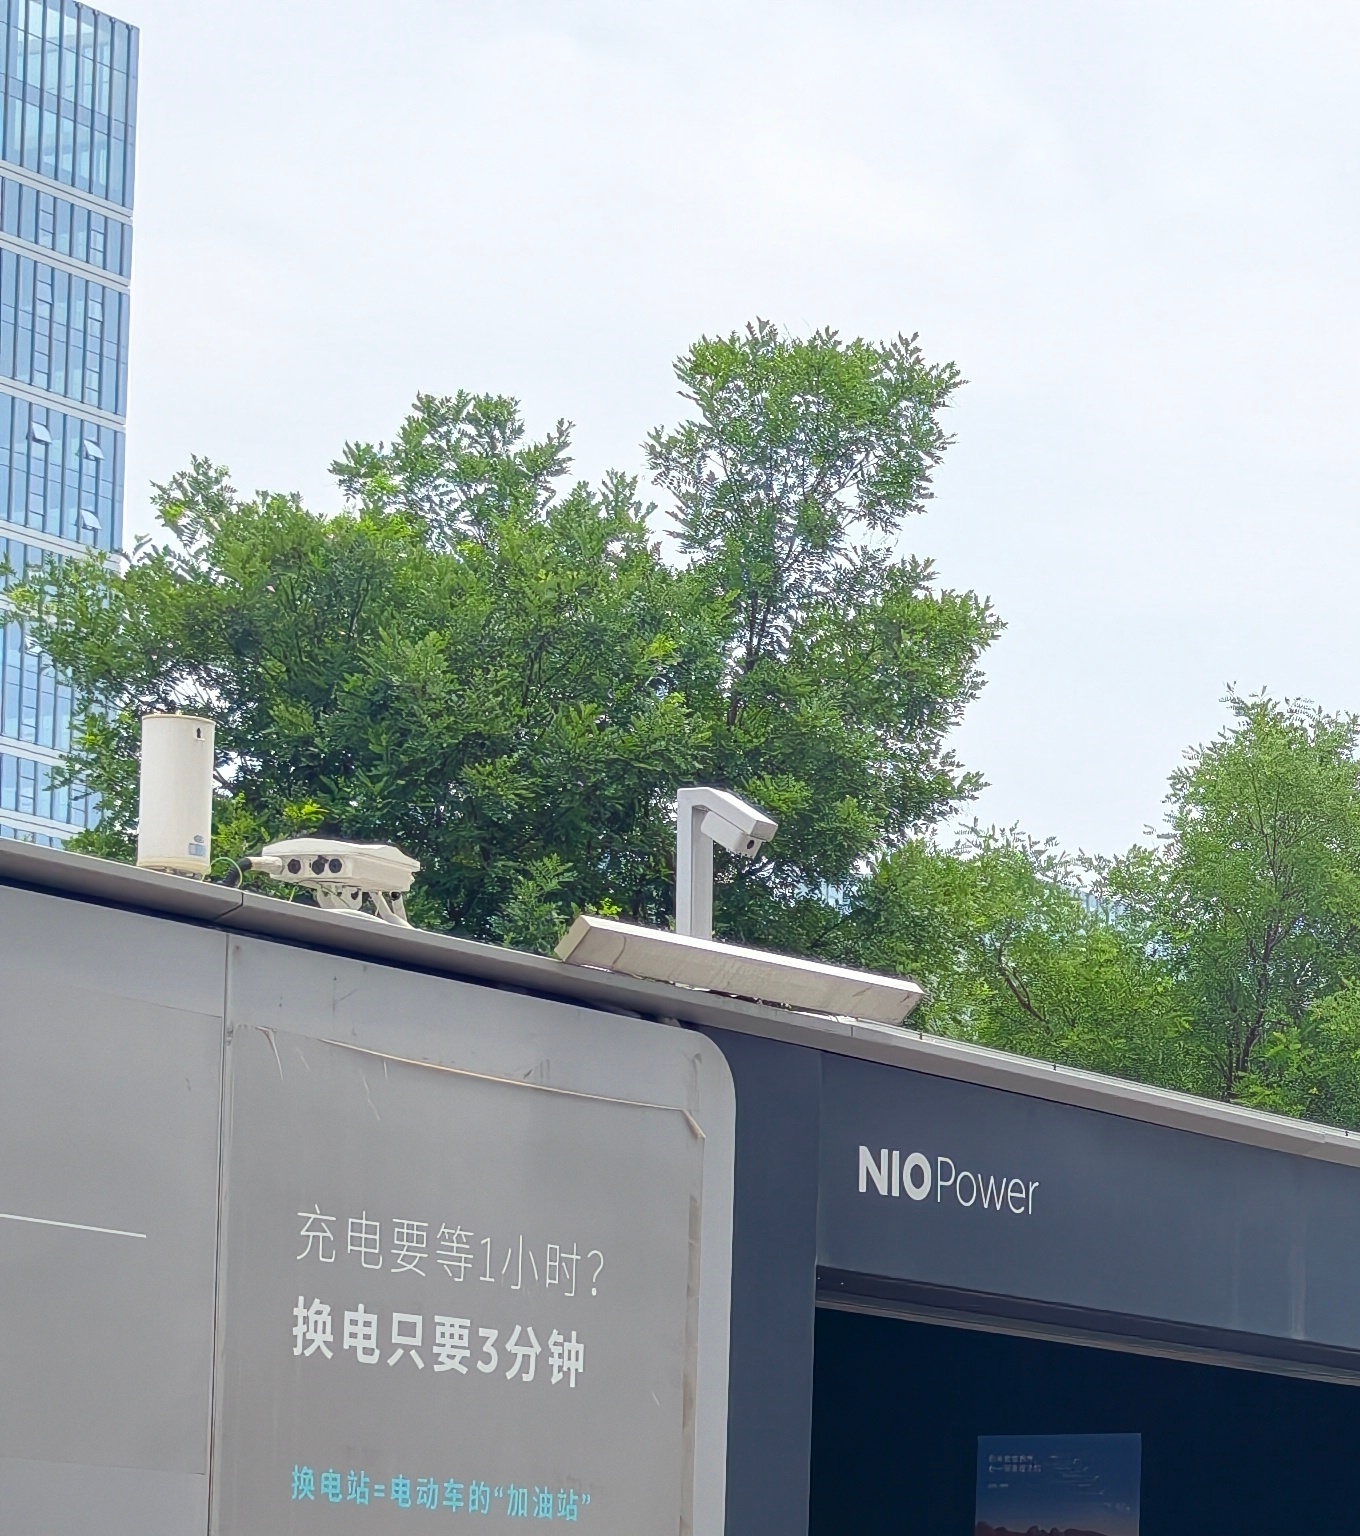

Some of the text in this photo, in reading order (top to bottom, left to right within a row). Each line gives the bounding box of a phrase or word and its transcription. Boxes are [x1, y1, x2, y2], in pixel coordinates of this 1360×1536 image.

[296, 1204, 604, 1297] 充电要等1小时?
[292, 1296, 585, 1388] 换电只要3分钟
